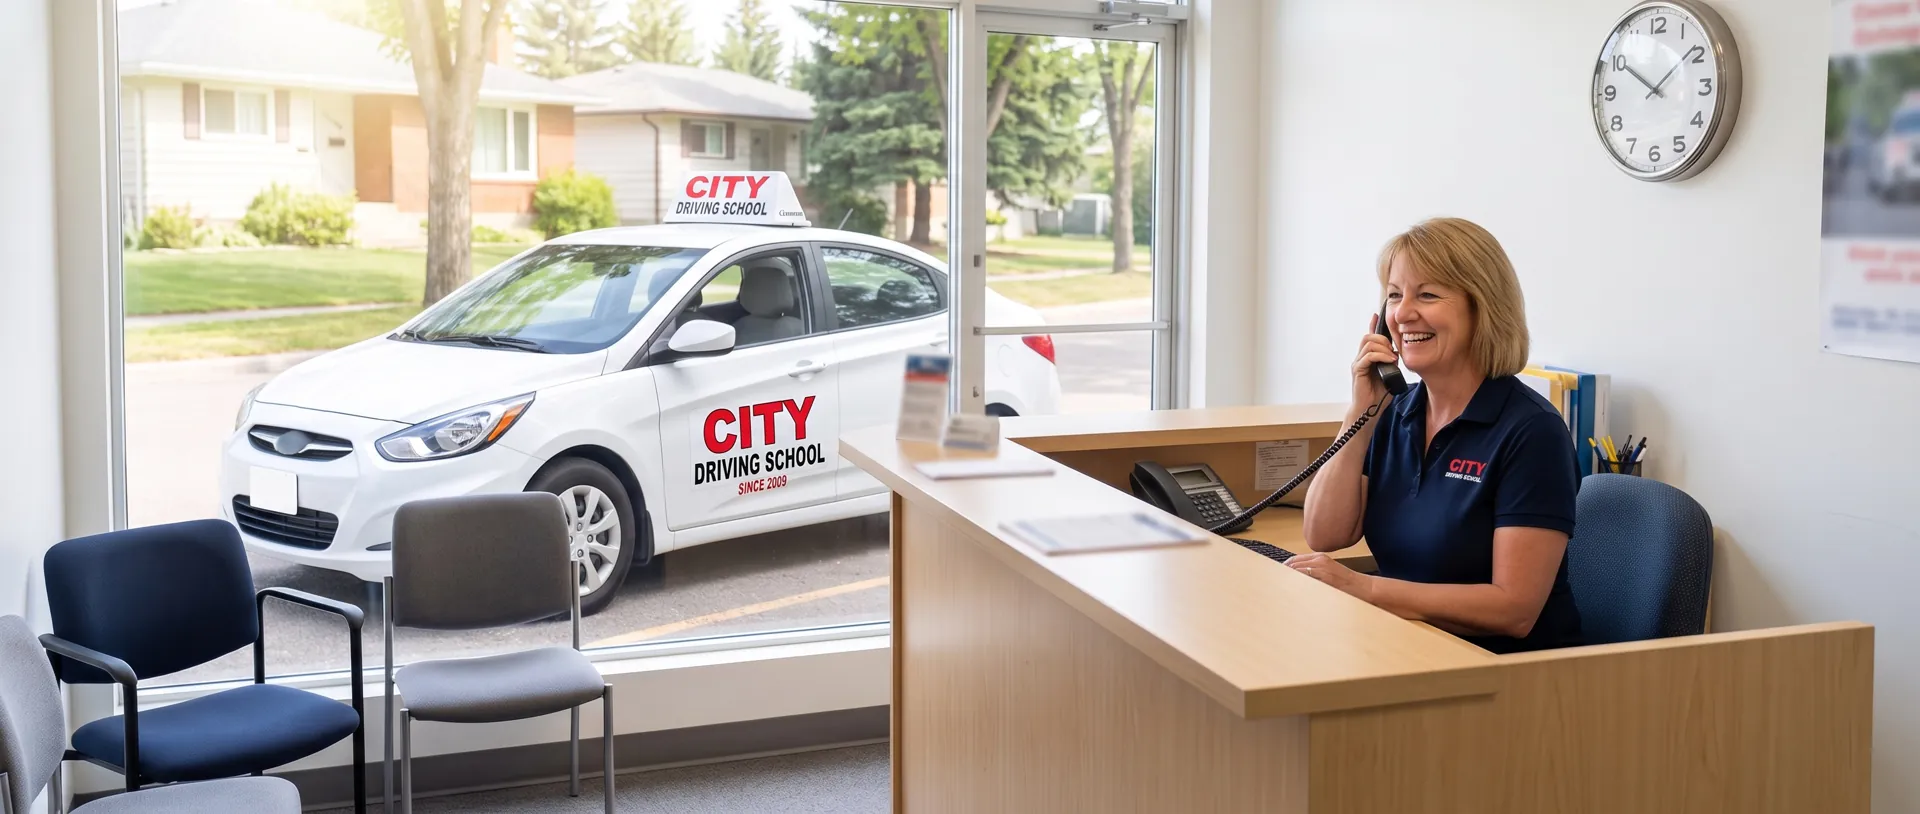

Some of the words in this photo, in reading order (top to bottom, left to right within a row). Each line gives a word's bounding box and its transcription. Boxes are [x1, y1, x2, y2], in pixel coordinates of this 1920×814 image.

[1650, 16, 1667, 35] 12
[1681, 23, 1685, 40] 1
[1612, 54, 1626, 72] 10
[1691, 46, 1705, 64] 2
[1604, 85, 1617, 102] 9
[1698, 78, 1712, 96] 3
[1610, 115, 1623, 132] 8
[1689, 111, 1704, 129] 4
[1625, 137, 1637, 155] 7
[1673, 135, 1686, 153] 5
[1648, 145, 1661, 163] 6
[685, 175, 771, 199] CITY
[675, 201, 720, 215] DRIVING
[722, 201, 768, 216] SCHOOL
[703, 395, 816, 454] CITY
[694, 453, 760, 485] DRIVING
[765, 443, 826, 473] SCHOOL
[1449, 458, 1487, 476] CITY
[738, 479, 765, 496] SINCE
[766, 474, 788, 490] 2009
